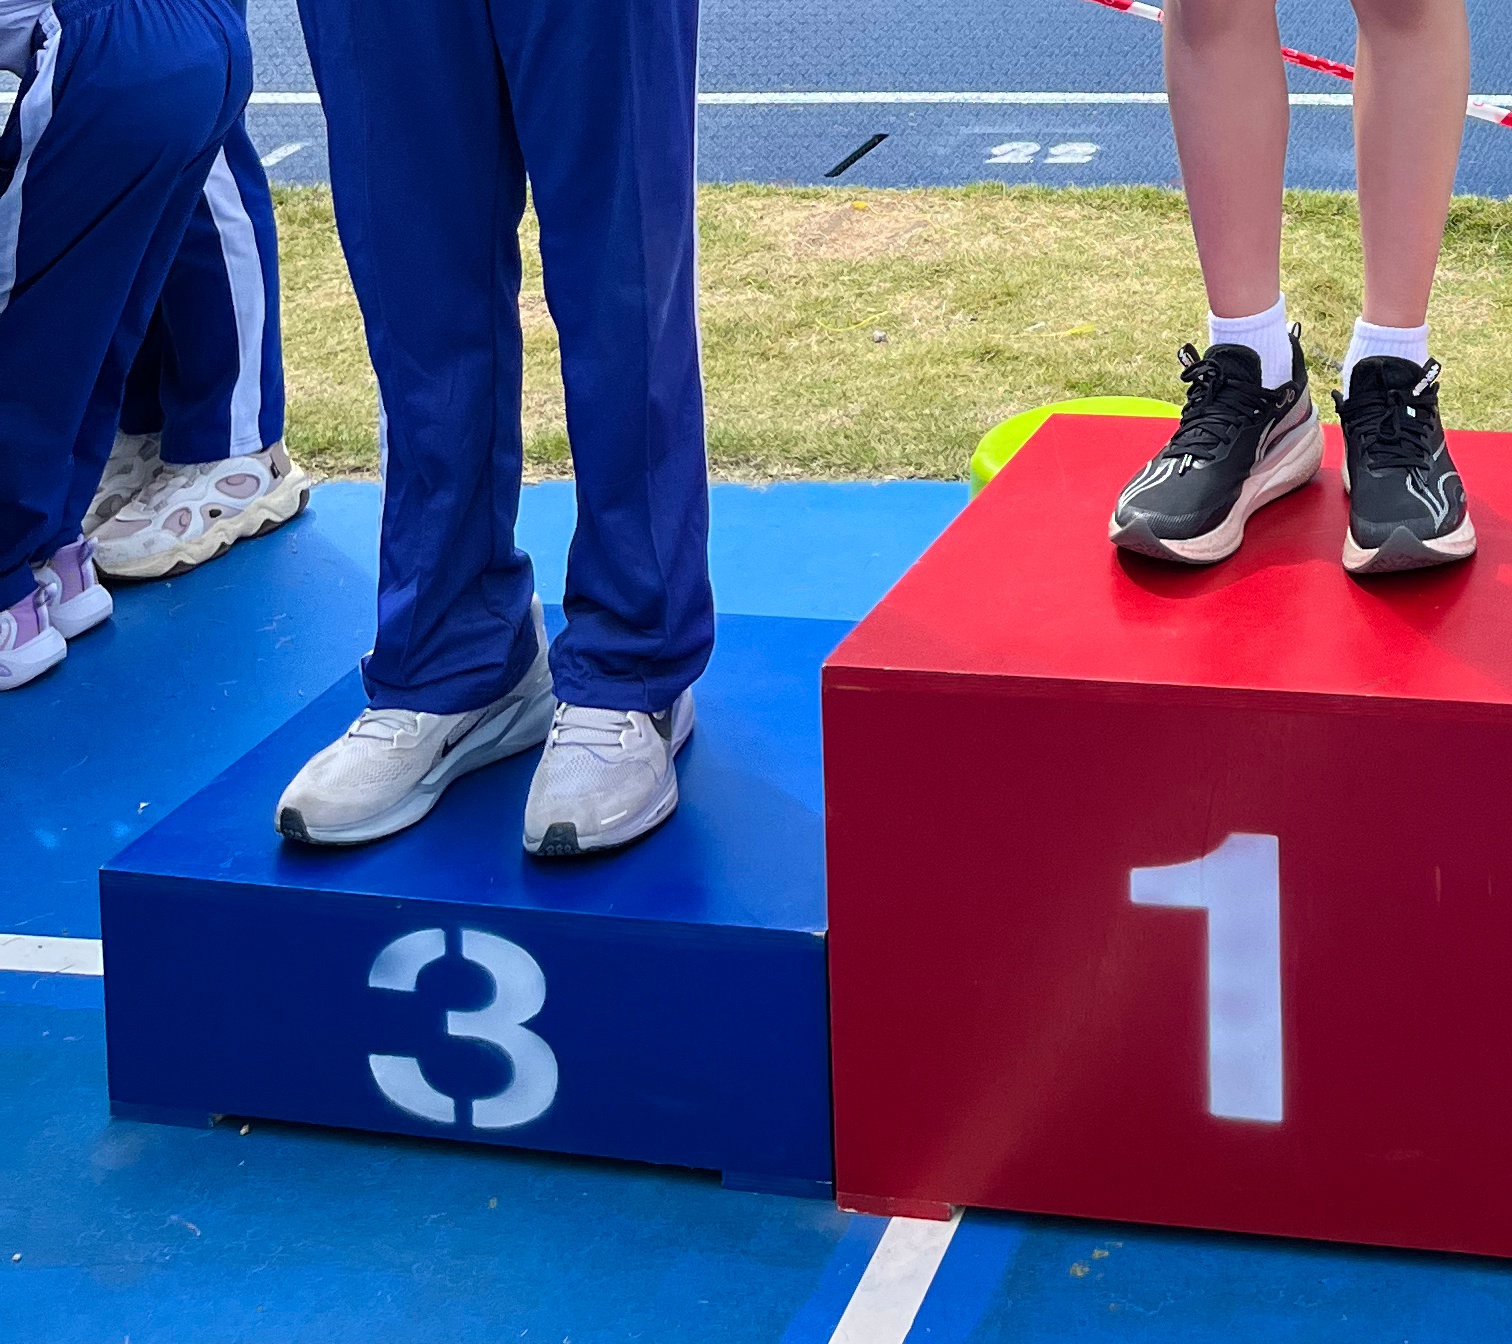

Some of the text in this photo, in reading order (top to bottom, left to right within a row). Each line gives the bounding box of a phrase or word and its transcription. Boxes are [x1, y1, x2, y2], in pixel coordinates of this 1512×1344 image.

[985, 141, 1101, 163] 22
[368, 927, 559, 1128] 3
[1129, 831, 1284, 1123] 1
